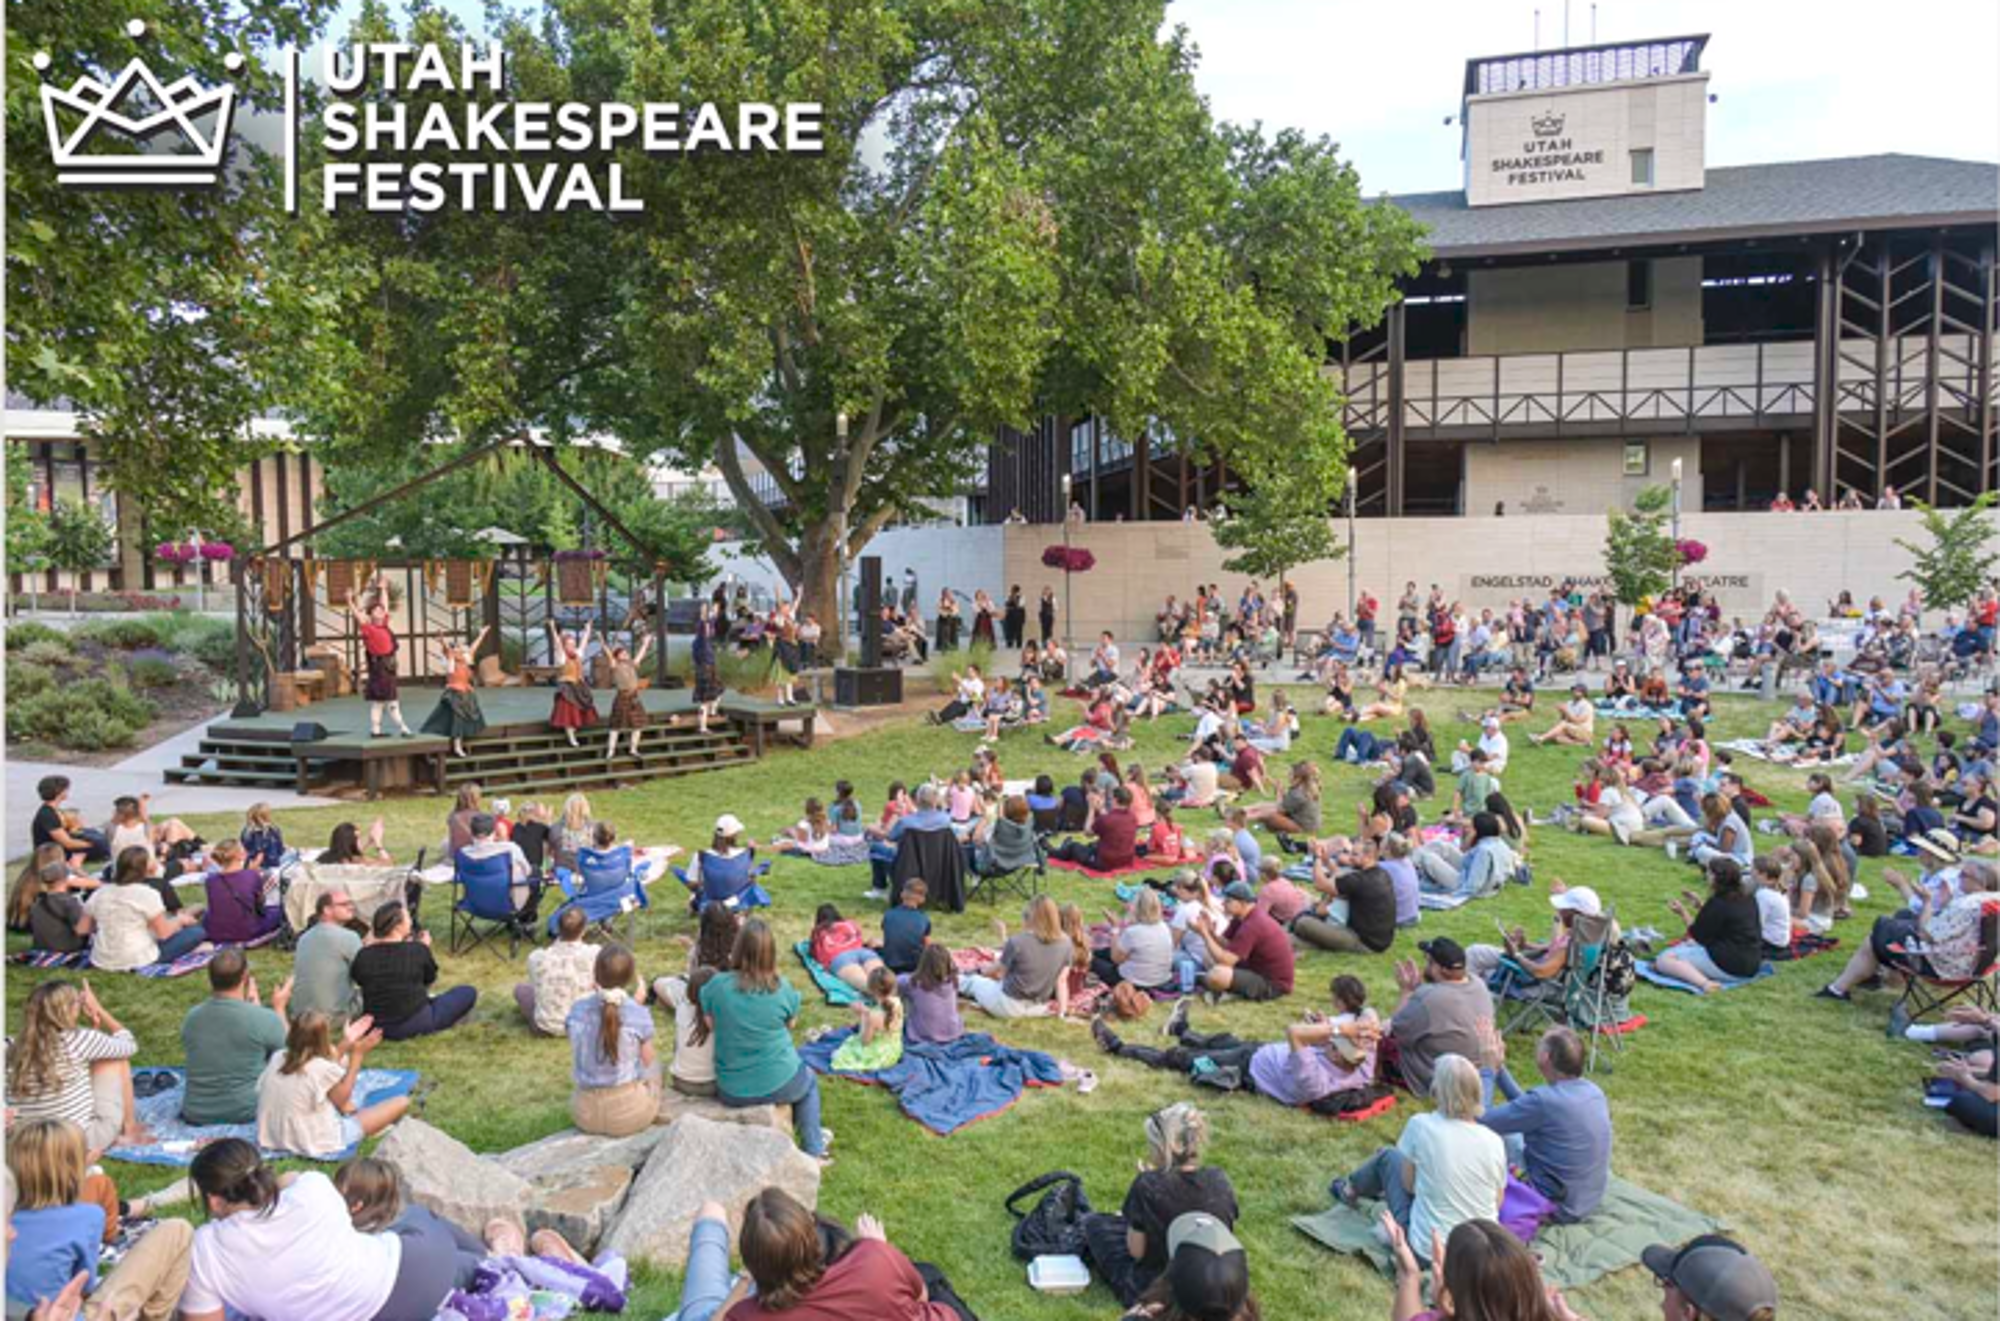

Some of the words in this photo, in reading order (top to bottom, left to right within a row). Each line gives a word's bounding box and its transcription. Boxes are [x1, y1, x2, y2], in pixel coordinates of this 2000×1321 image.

[1523, 138, 1572, 153] UTAH
[1492, 149, 1604, 172] SHAKESPEARE
[1507, 168, 1586, 185] FESTIVAL
[1470, 575, 1553, 588] ENGELSTAD
